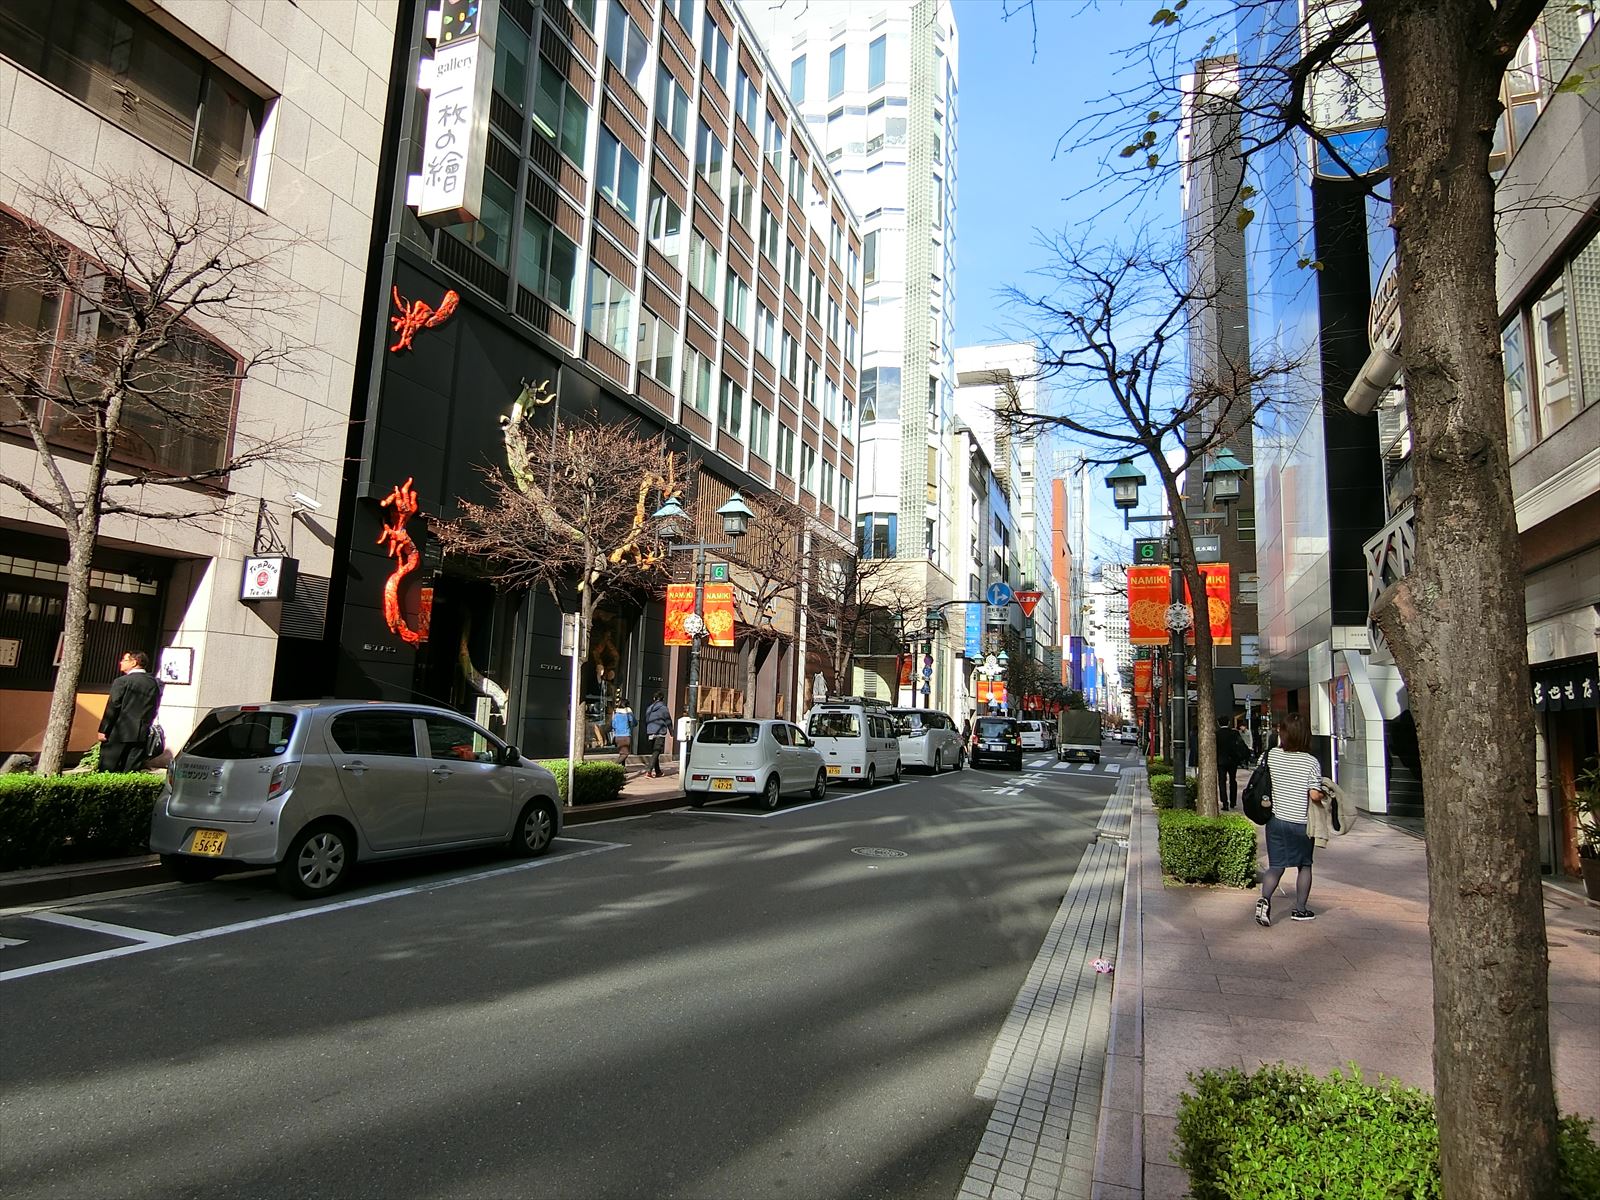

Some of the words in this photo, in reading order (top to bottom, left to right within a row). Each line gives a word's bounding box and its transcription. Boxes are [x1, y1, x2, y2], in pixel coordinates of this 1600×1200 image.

[437, 55, 473, 77] gallery
[426, 86, 468, 194] 一枚の繪
[1141, 544, 1154, 558] 6
[714, 566, 724, 578] 6
[1130, 575, 1167, 585] NAMIKI
[1206, 575, 1226, 583] MIKI
